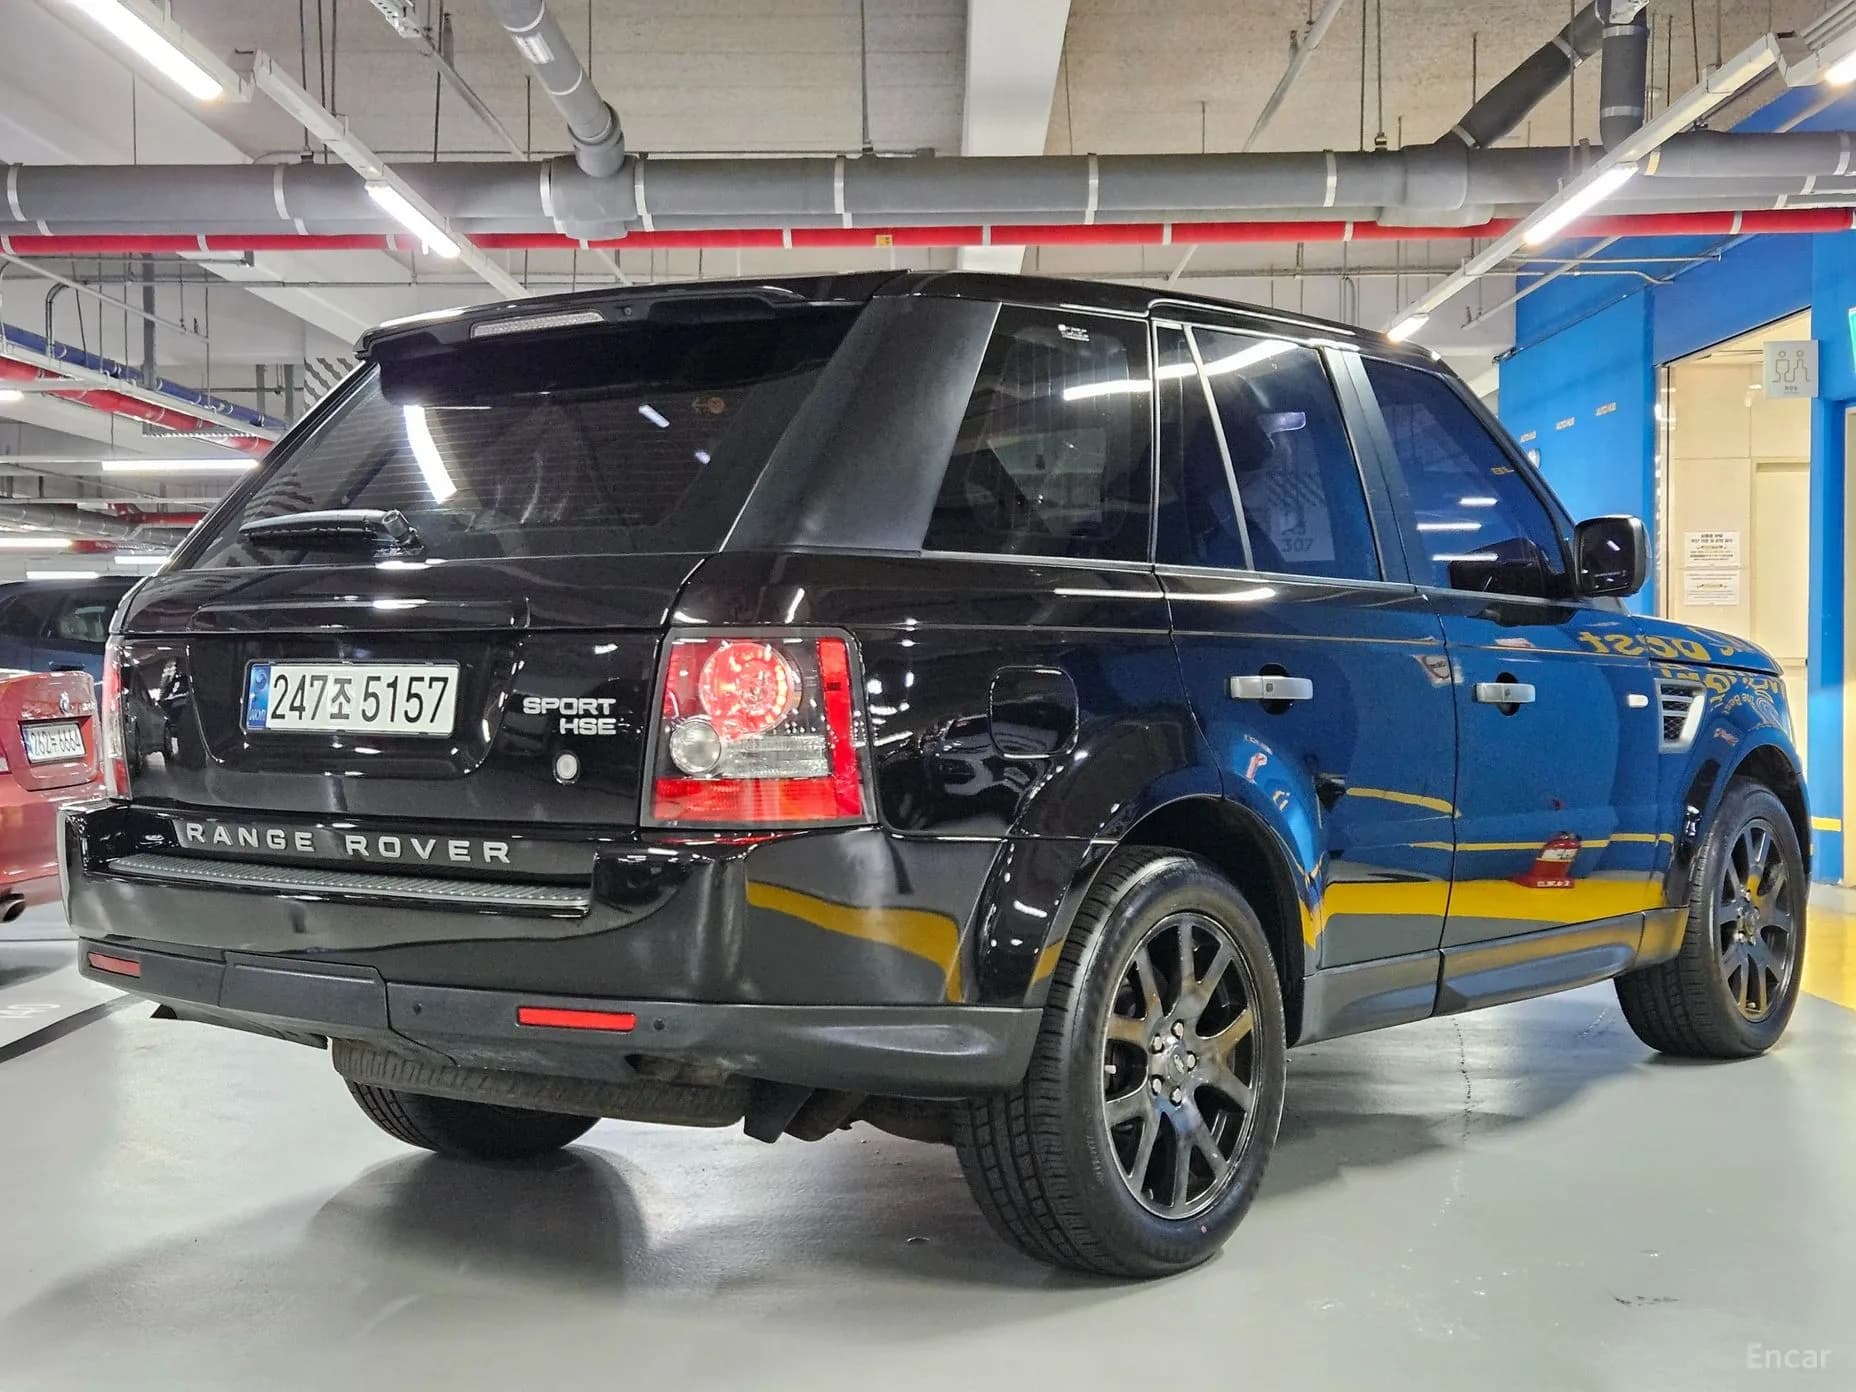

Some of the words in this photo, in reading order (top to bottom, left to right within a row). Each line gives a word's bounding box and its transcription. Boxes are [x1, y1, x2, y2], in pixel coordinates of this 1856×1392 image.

[270, 673, 352, 721] 247조
[361, 674, 449, 724] 5157
[522, 697, 617, 715] SPORT
[559, 717, 617, 735] HSE
[186, 823, 315, 852] RANGE
[345, 834, 511, 864] ROVER
